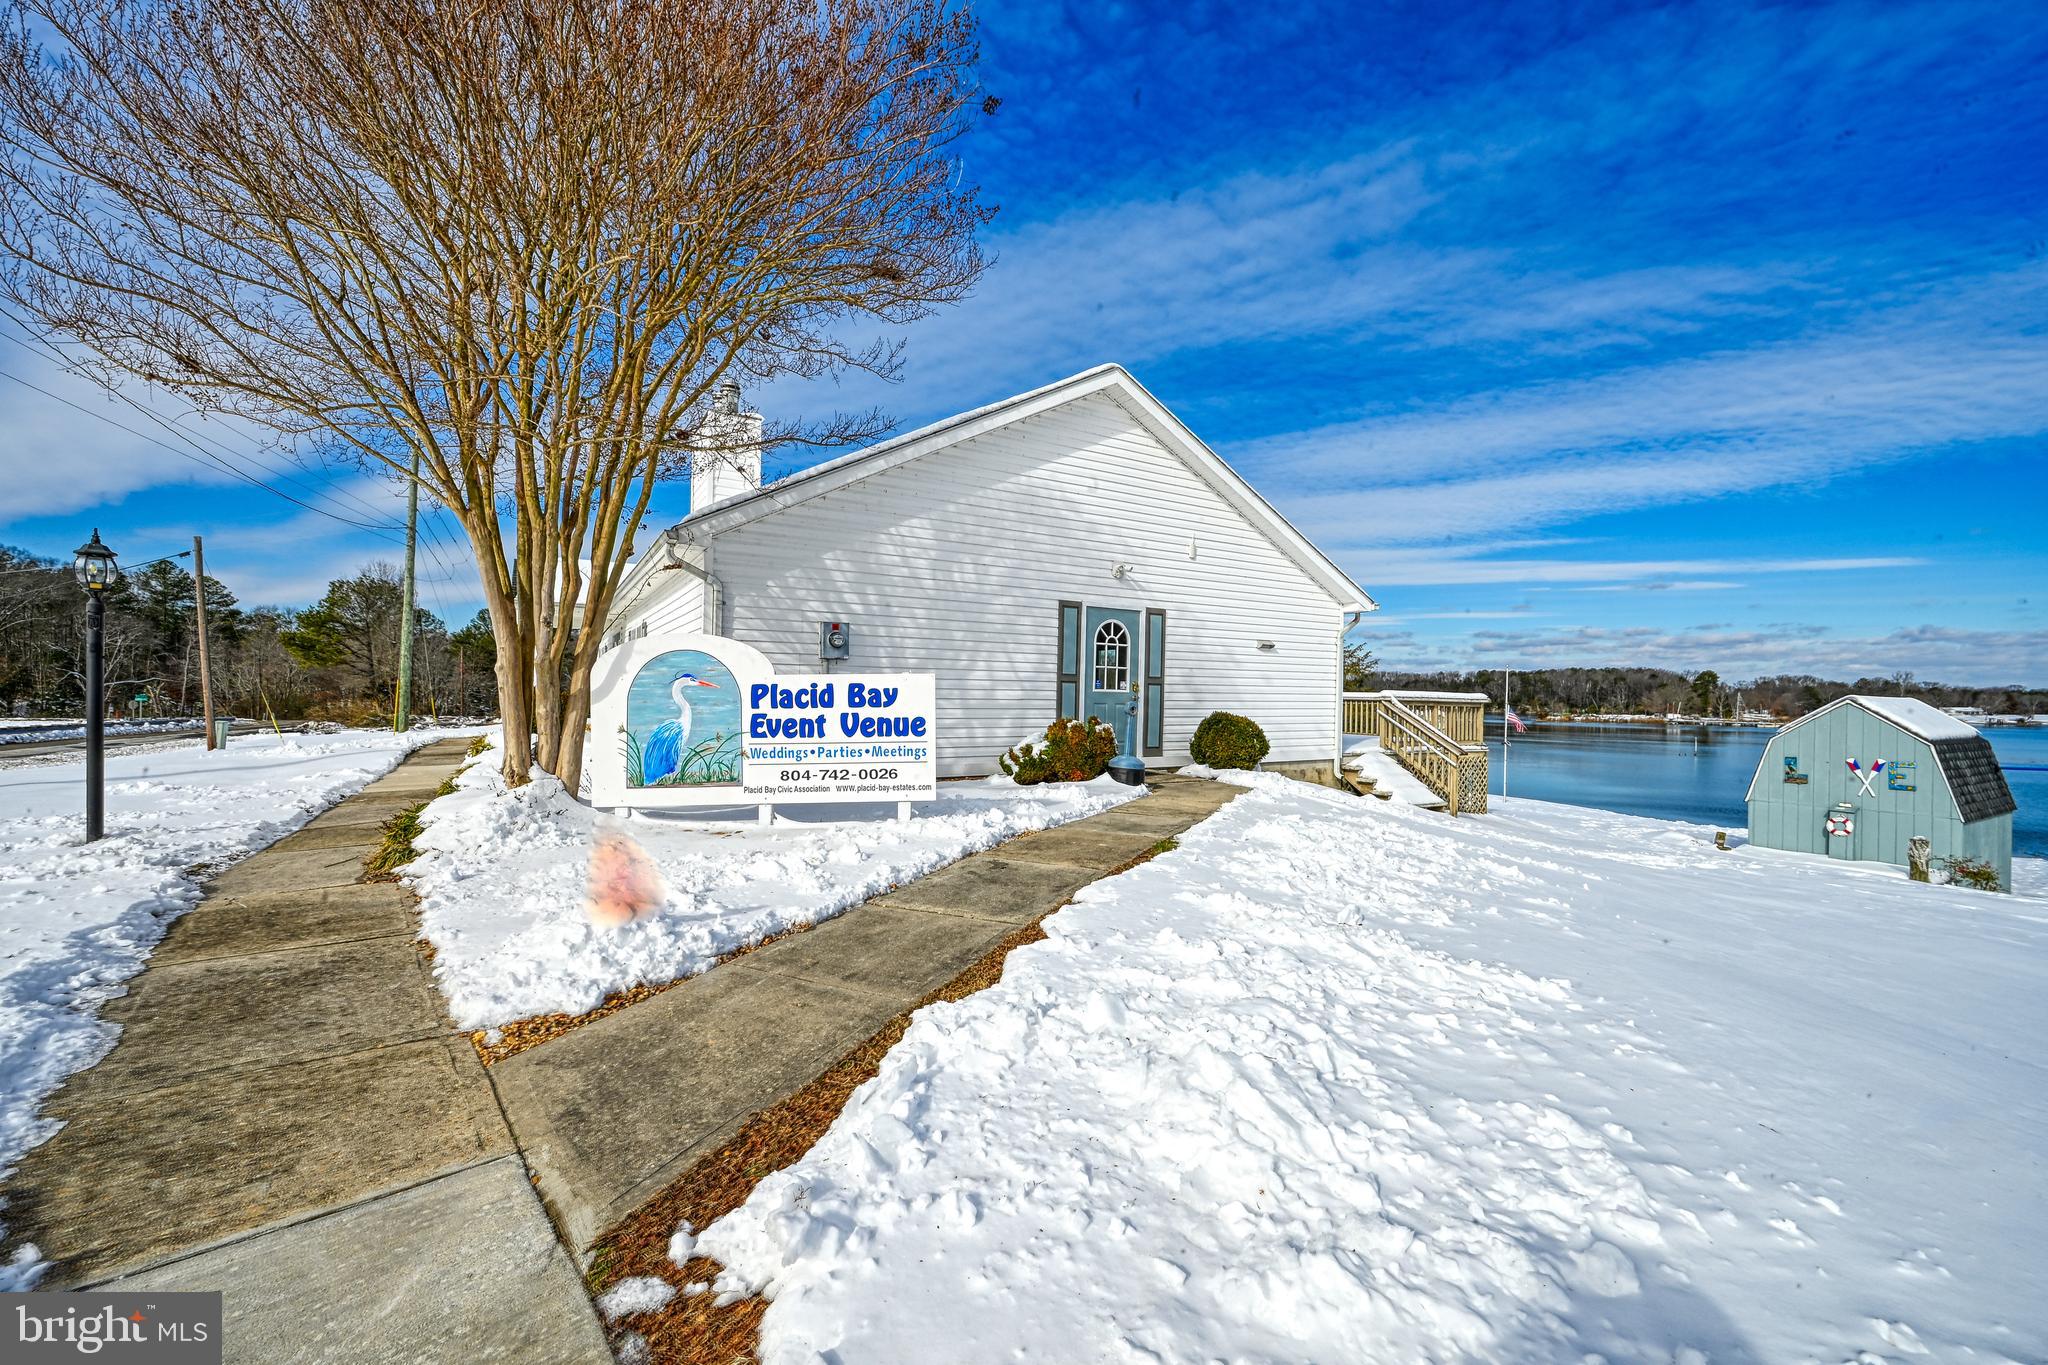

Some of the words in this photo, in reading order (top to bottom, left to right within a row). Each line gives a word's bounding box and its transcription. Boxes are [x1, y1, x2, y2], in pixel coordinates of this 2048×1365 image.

[750, 683, 834, 709] Placid
[847, 683, 898, 708] Bay
[750, 713, 826, 738] Event
[840, 712, 926, 738] Venue
[750, 747, 808, 761] Weddings
[817, 746, 863, 758] Parties
[871, 745, 927, 759] Meetings
[780, 768, 898, 781] 804-742-0026
[743, 786, 763, 794] Placid
[765, 786, 777, 795] Bay
[777, 785, 793, 793] Civic
[794, 785, 830, 793] Association
[836, 783, 932, 794] www.placid-bay-estates.com
